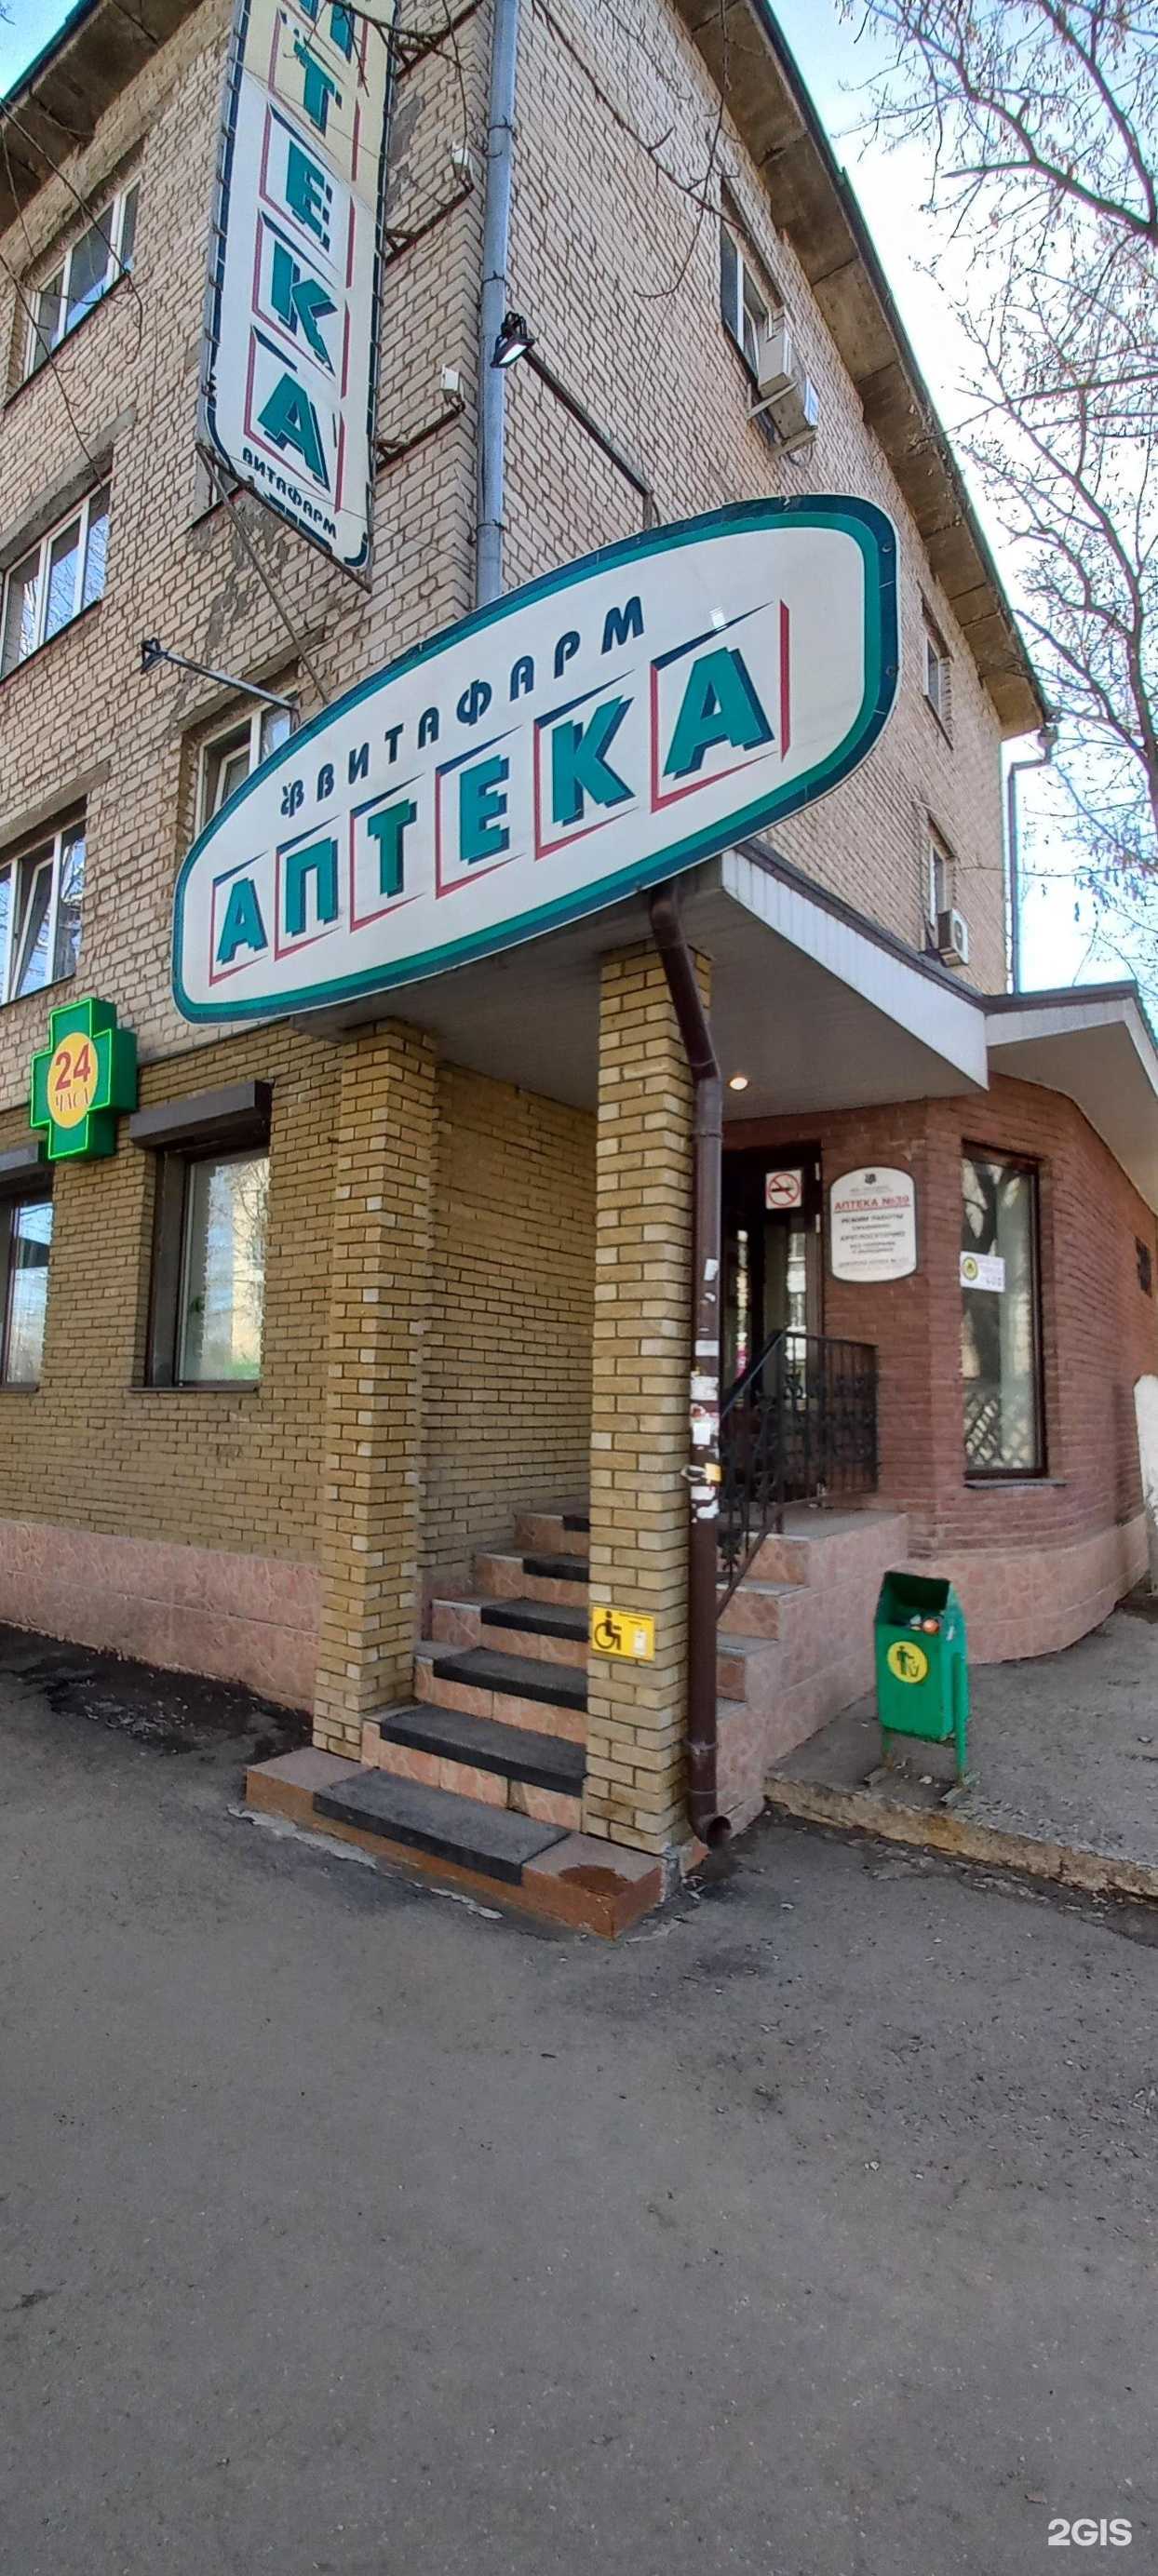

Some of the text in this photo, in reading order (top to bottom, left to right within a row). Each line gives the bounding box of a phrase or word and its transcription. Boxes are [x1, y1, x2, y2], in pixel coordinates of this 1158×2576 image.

[242, 446, 338, 540] ВИТАФАРМ
[316, 595, 645, 803] ВИТАФАРМ
[216, 647, 774, 965] АПТЕКА
[55, 1042, 91, 1092] 24
[55, 1086, 89, 1112] ЧАСА
[834, 1198, 879, 1211] АПТЕКА
